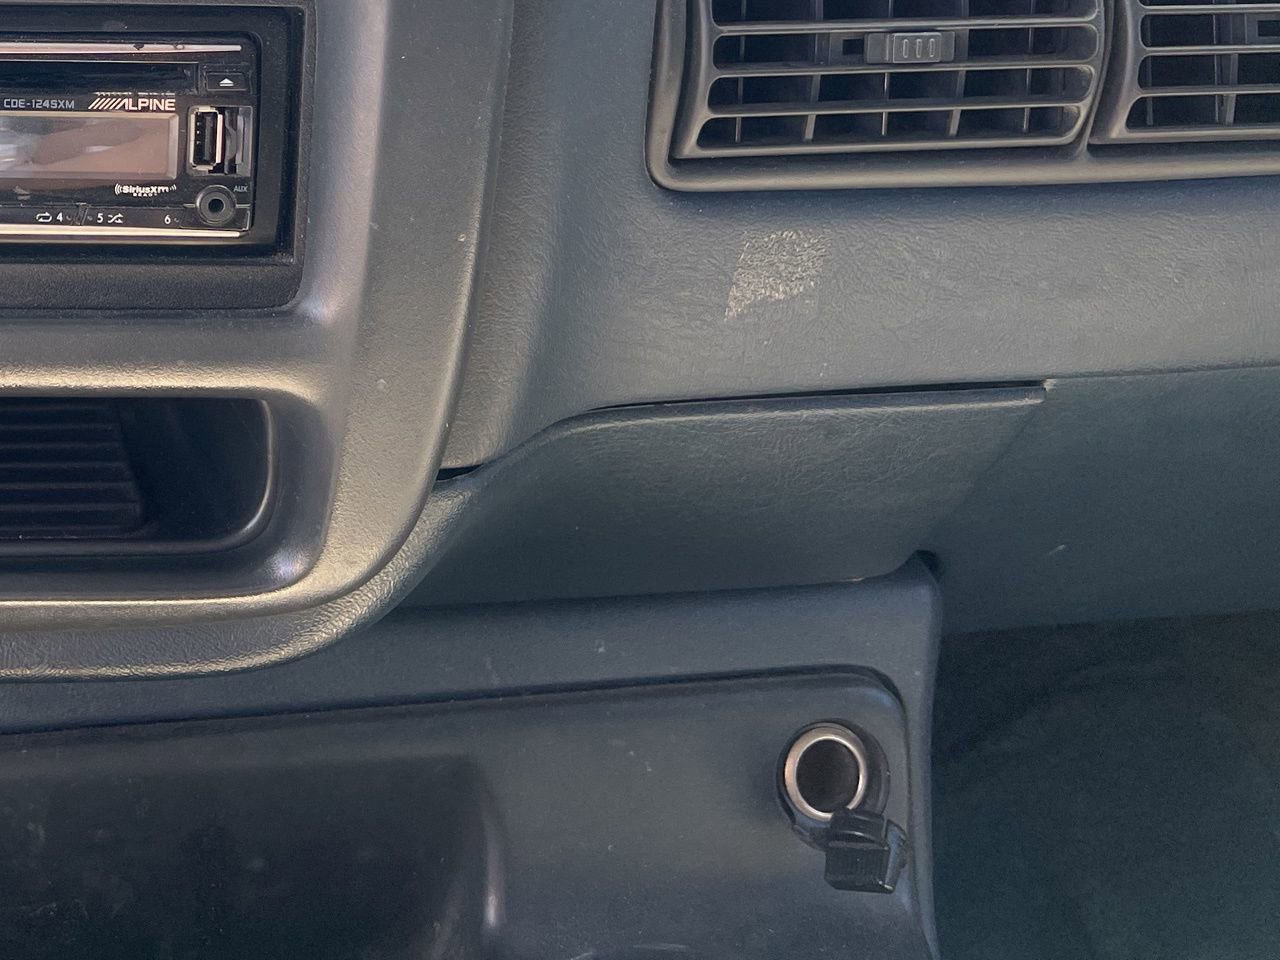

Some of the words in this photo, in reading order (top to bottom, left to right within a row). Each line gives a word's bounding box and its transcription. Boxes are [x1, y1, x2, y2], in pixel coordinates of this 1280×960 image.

[3, 98, 75, 109] CDE-124SXM
[114, 97, 176, 111] ALPINE
[233, 185, 248, 193] AUX
[56, 212, 64, 223] 4
[96, 213, 104, 223] 5
[164, 214, 171, 225] 6
